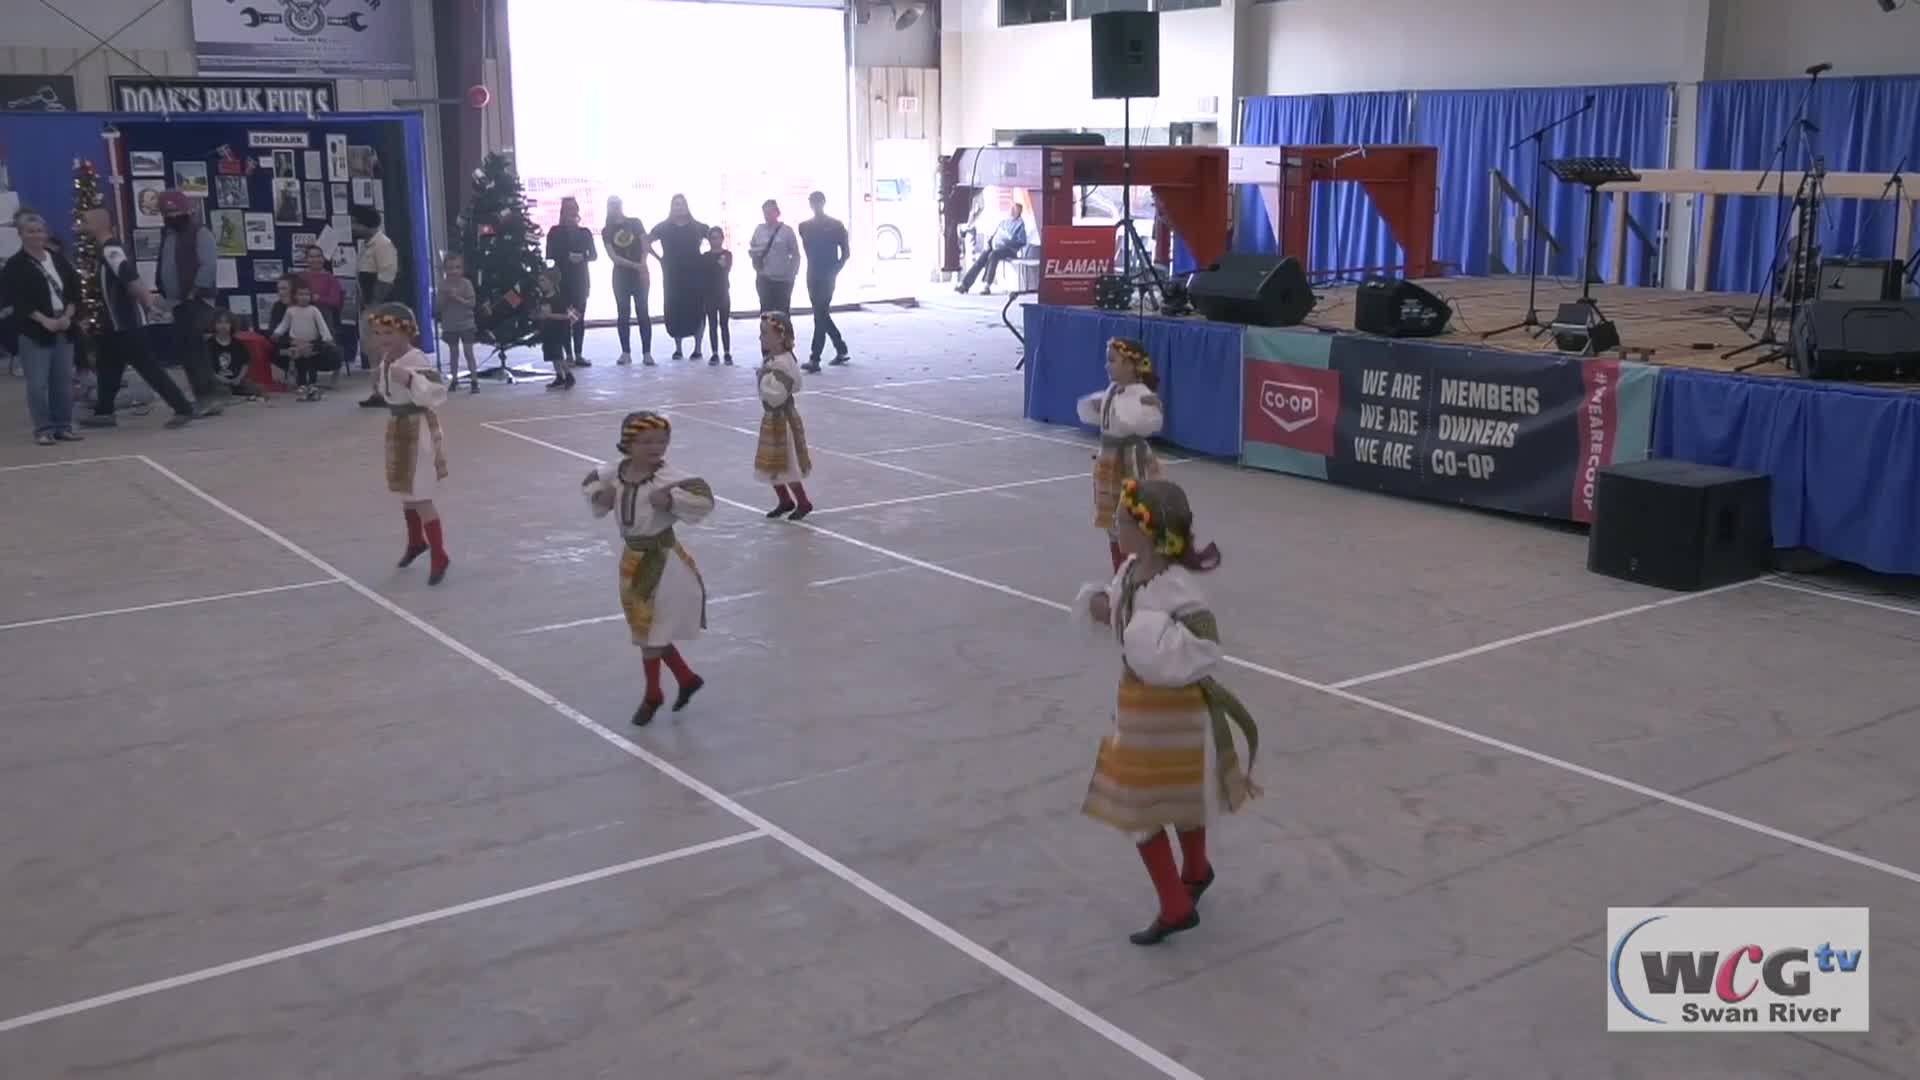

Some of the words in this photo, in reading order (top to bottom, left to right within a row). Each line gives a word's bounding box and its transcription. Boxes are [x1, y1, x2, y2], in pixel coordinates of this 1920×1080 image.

[120, 87, 202, 112] DOAK'S
[203, 87, 263, 112] BULK
[253, 135, 305, 144] DENMARK
[1044, 258, 1110, 274] FLAMAN
[1361, 369, 1388, 396] WE
[1391, 372, 1422, 400] ARE
[1440, 378, 1540, 415] MEMBERS
[1359, 403, 1385, 431] WE
[1387, 407, 1418, 436] ARE
[1438, 414, 1519, 448] OWNERS
[1354, 436, 1380, 465] WE
[1382, 440, 1413, 470] ARE
[1431, 449, 1496, 480] CO-OP
